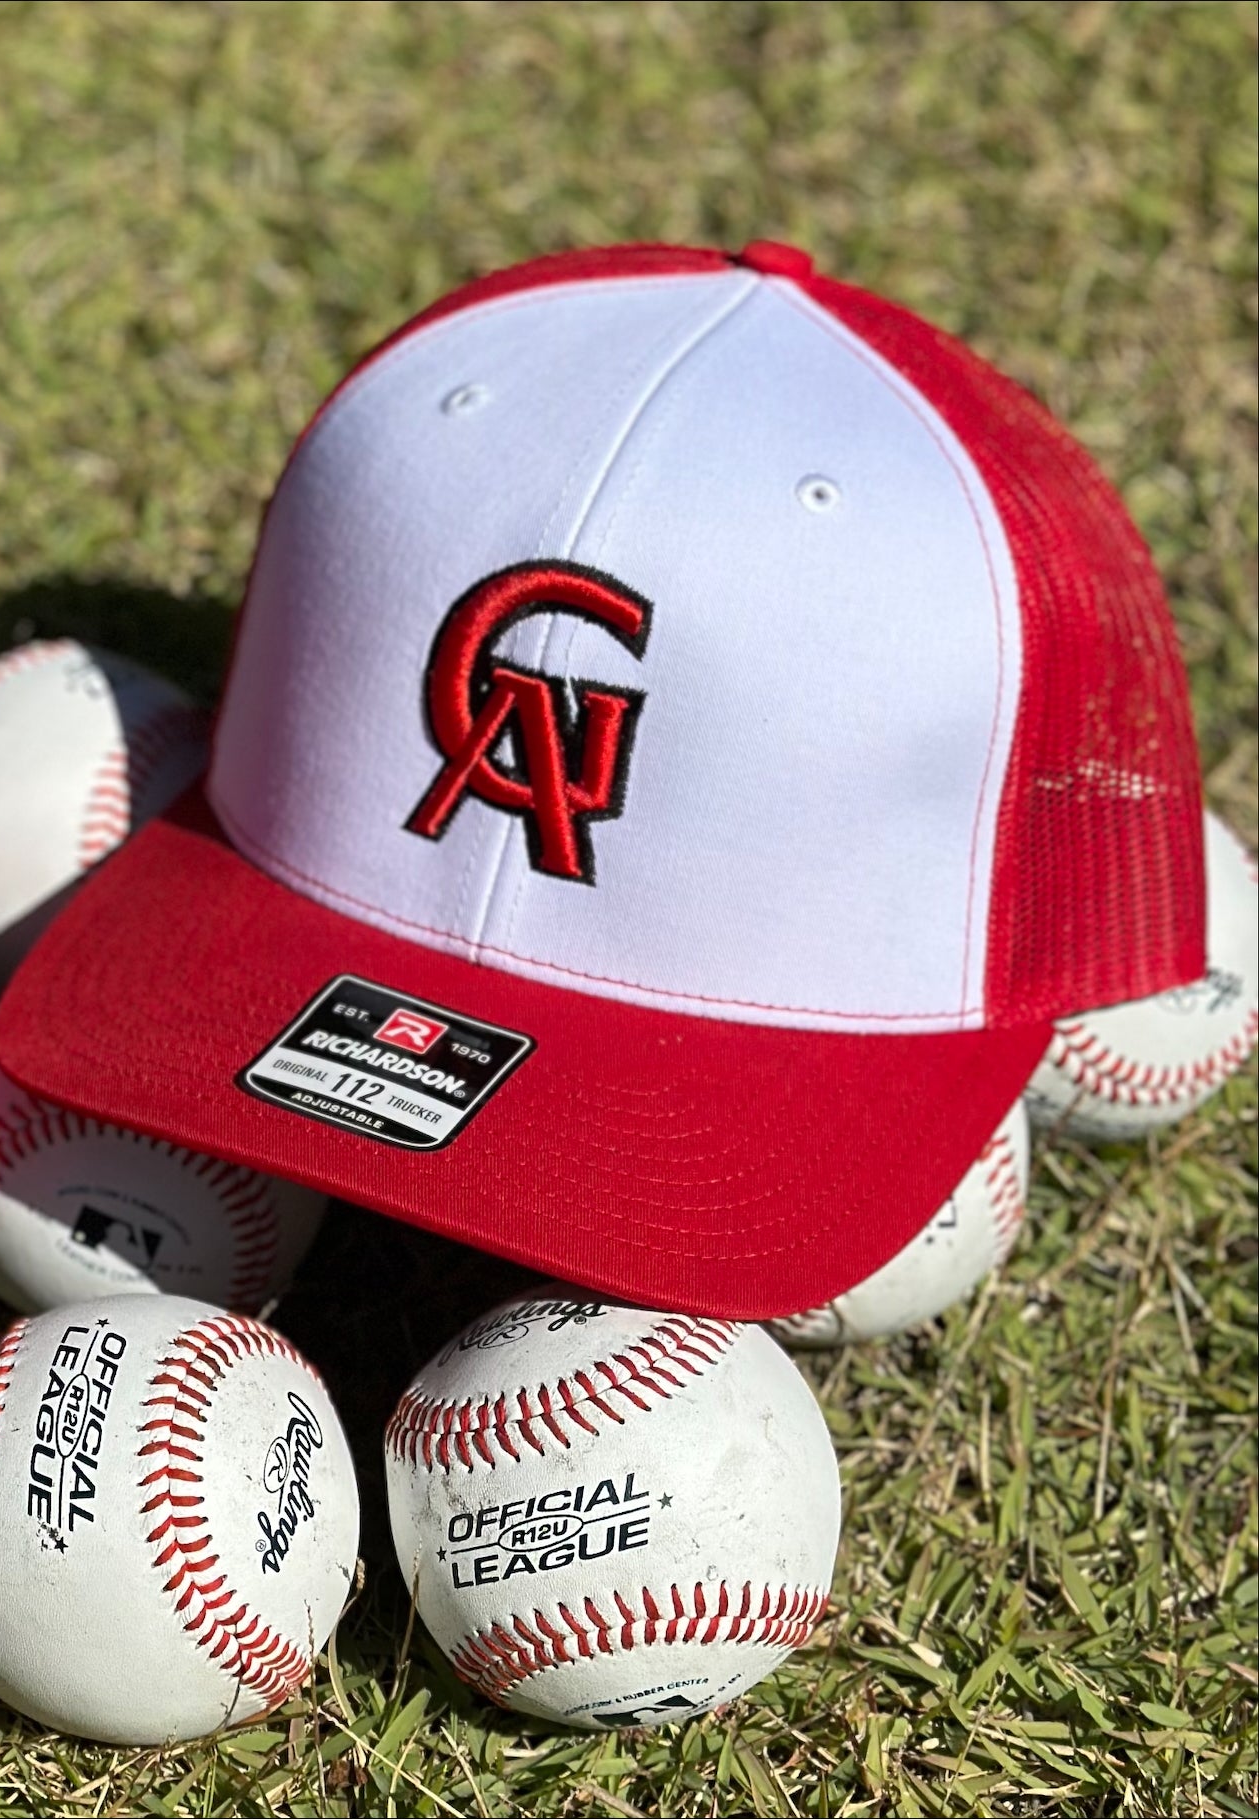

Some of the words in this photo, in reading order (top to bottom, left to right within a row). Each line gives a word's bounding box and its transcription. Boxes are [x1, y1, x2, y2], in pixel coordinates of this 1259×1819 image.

[333, 1003, 371, 1022] EST.
[450, 1041, 492, 1066] 1970
[272, 1058, 329, 1083] ORIGINAL
[329, 1072, 386, 1105] 112
[386, 1095, 443, 1125] TRUCKER
[291, 1092, 385, 1130] ADJUSTABLE
[27, 1326, 90, 1525] LEAGUE
[61, 1384, 85, 1445] R12U
[68, 1332, 127, 1532] OFFICIAL
[448, 1472, 650, 1543] OFFICIAL
[511, 1519, 568, 1548] R12U
[451, 1517, 650, 1589] LEAGUE
[667, 1677, 710, 1691] CENTER
